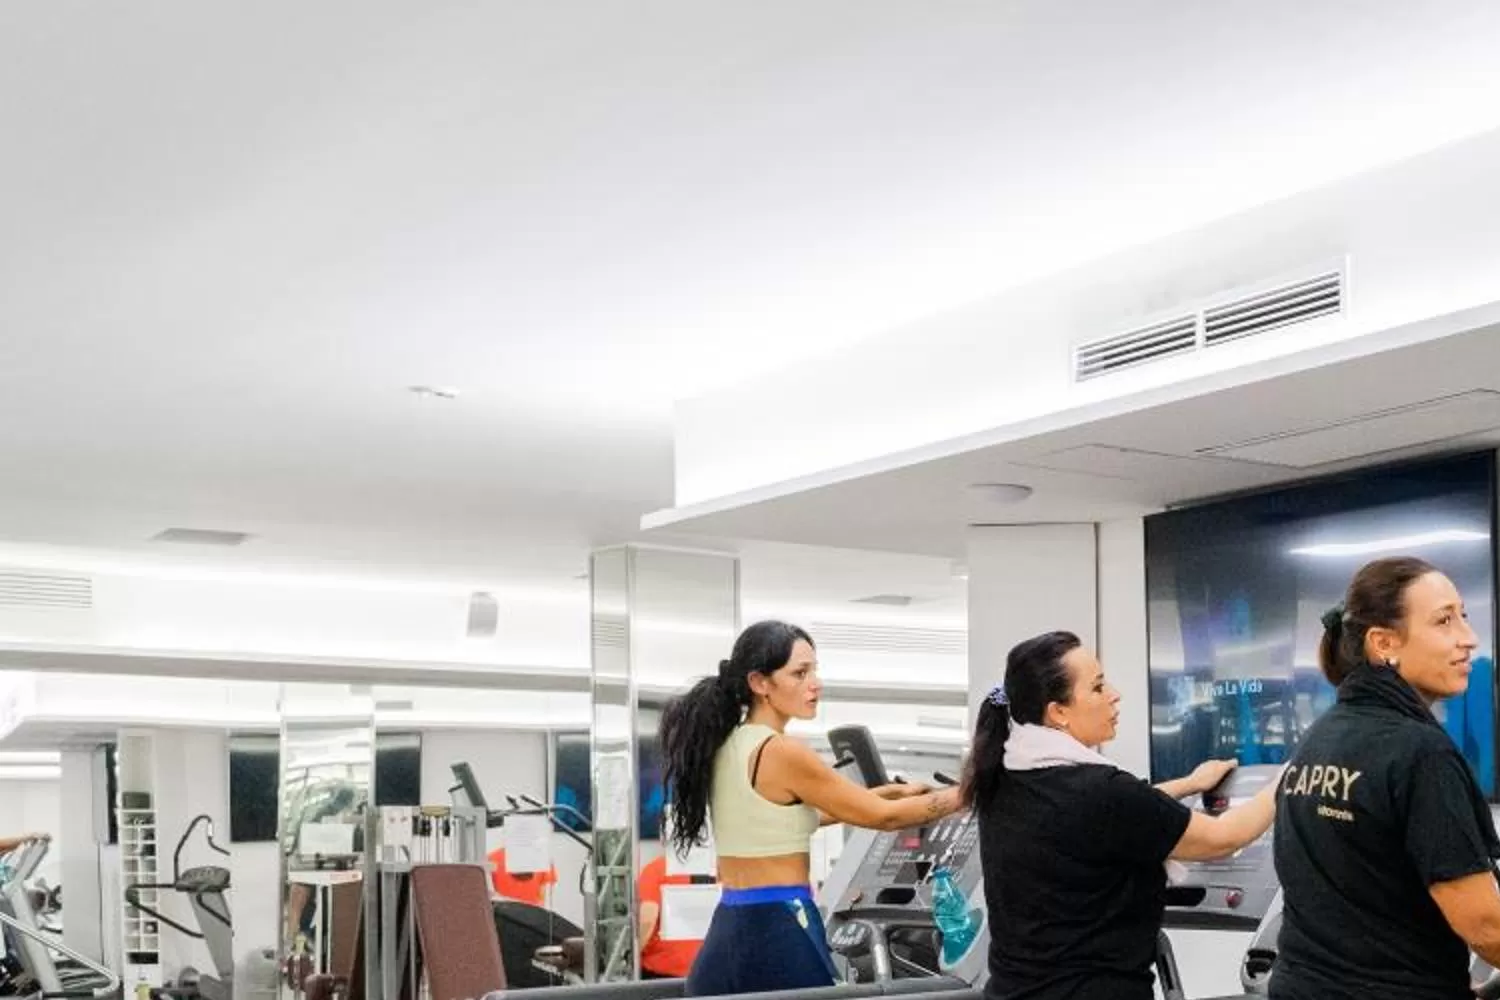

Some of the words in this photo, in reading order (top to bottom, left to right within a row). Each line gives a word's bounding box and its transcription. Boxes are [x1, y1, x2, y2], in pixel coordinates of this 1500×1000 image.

[1225, 679, 1238, 695] La
[1239, 677, 1264, 696] Vida
[1284, 764, 1362, 801] CAPRY
